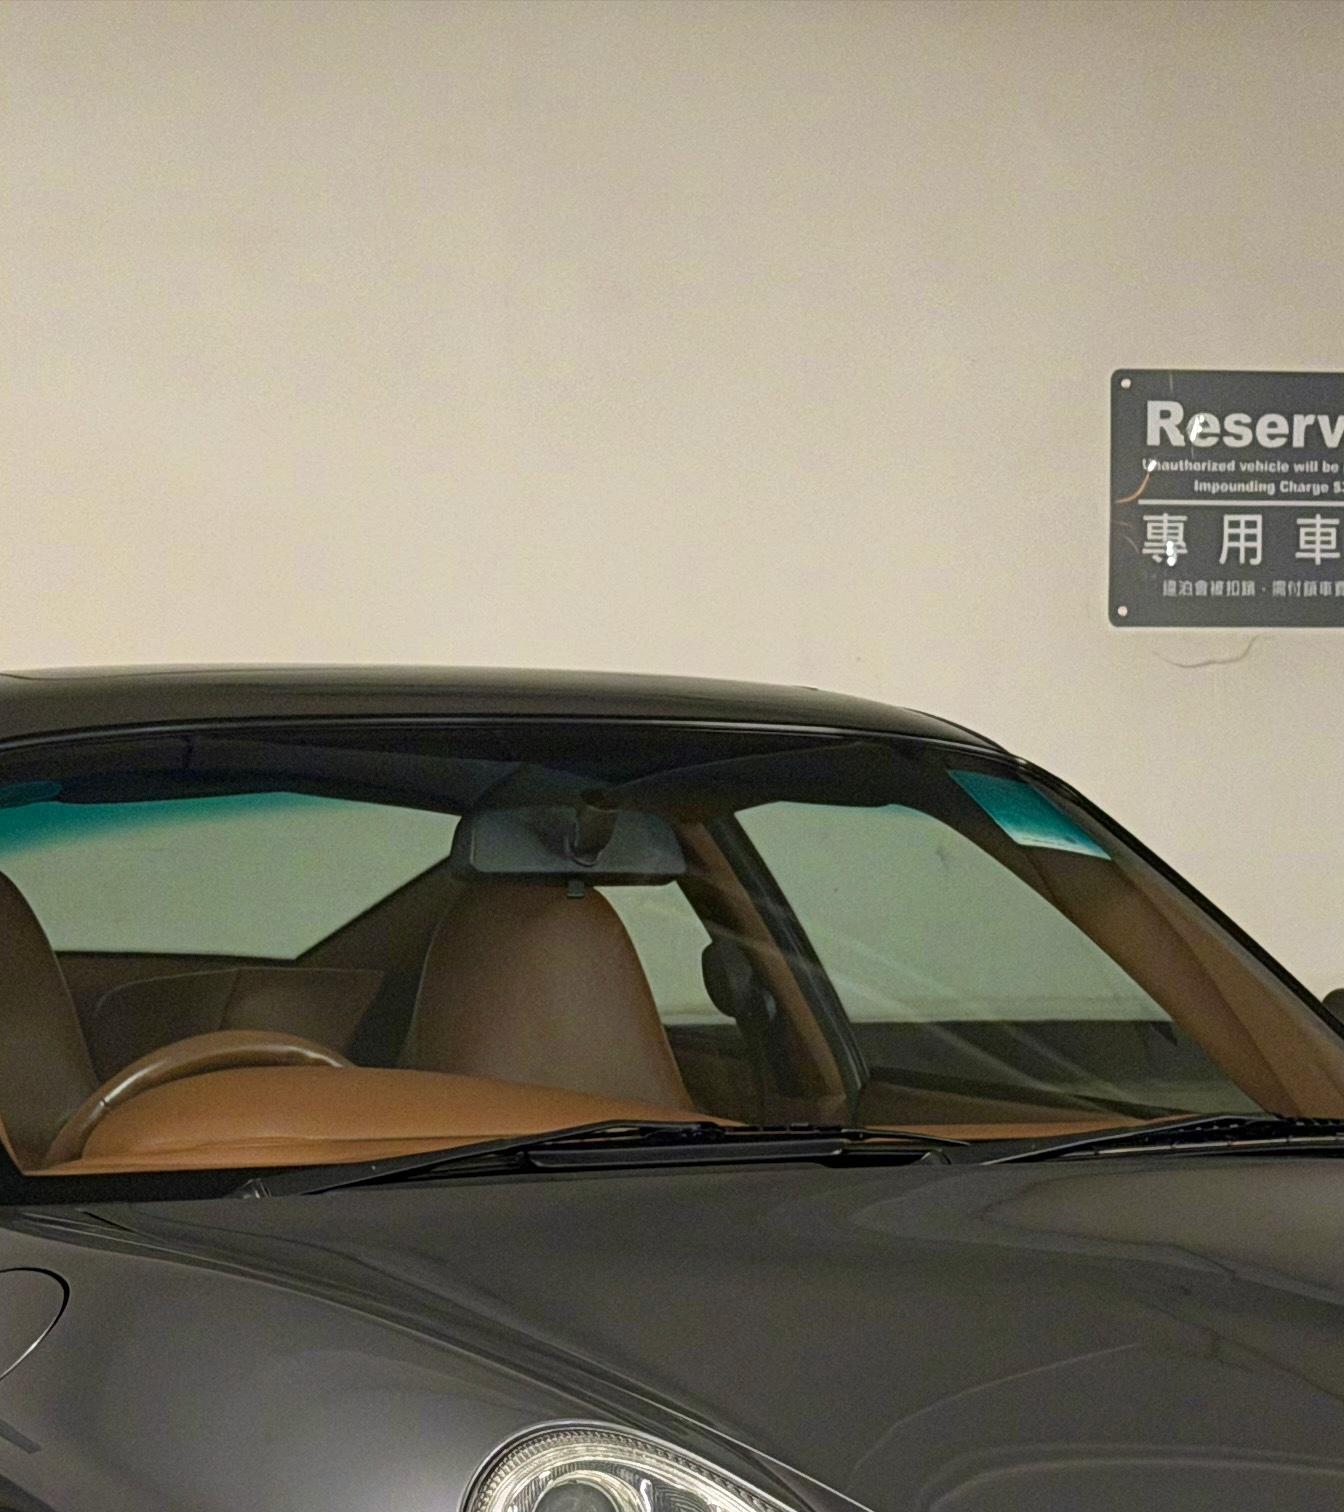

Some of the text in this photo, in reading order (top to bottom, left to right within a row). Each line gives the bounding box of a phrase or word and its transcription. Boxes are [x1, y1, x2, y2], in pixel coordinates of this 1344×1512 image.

[1239, 459, 1290, 473] vehicle
[1293, 460, 1318, 473] will
[1322, 460, 1339, 473] be
[1193, 480, 1276, 495] Impounding
[1279, 480, 1329, 496] Charge
